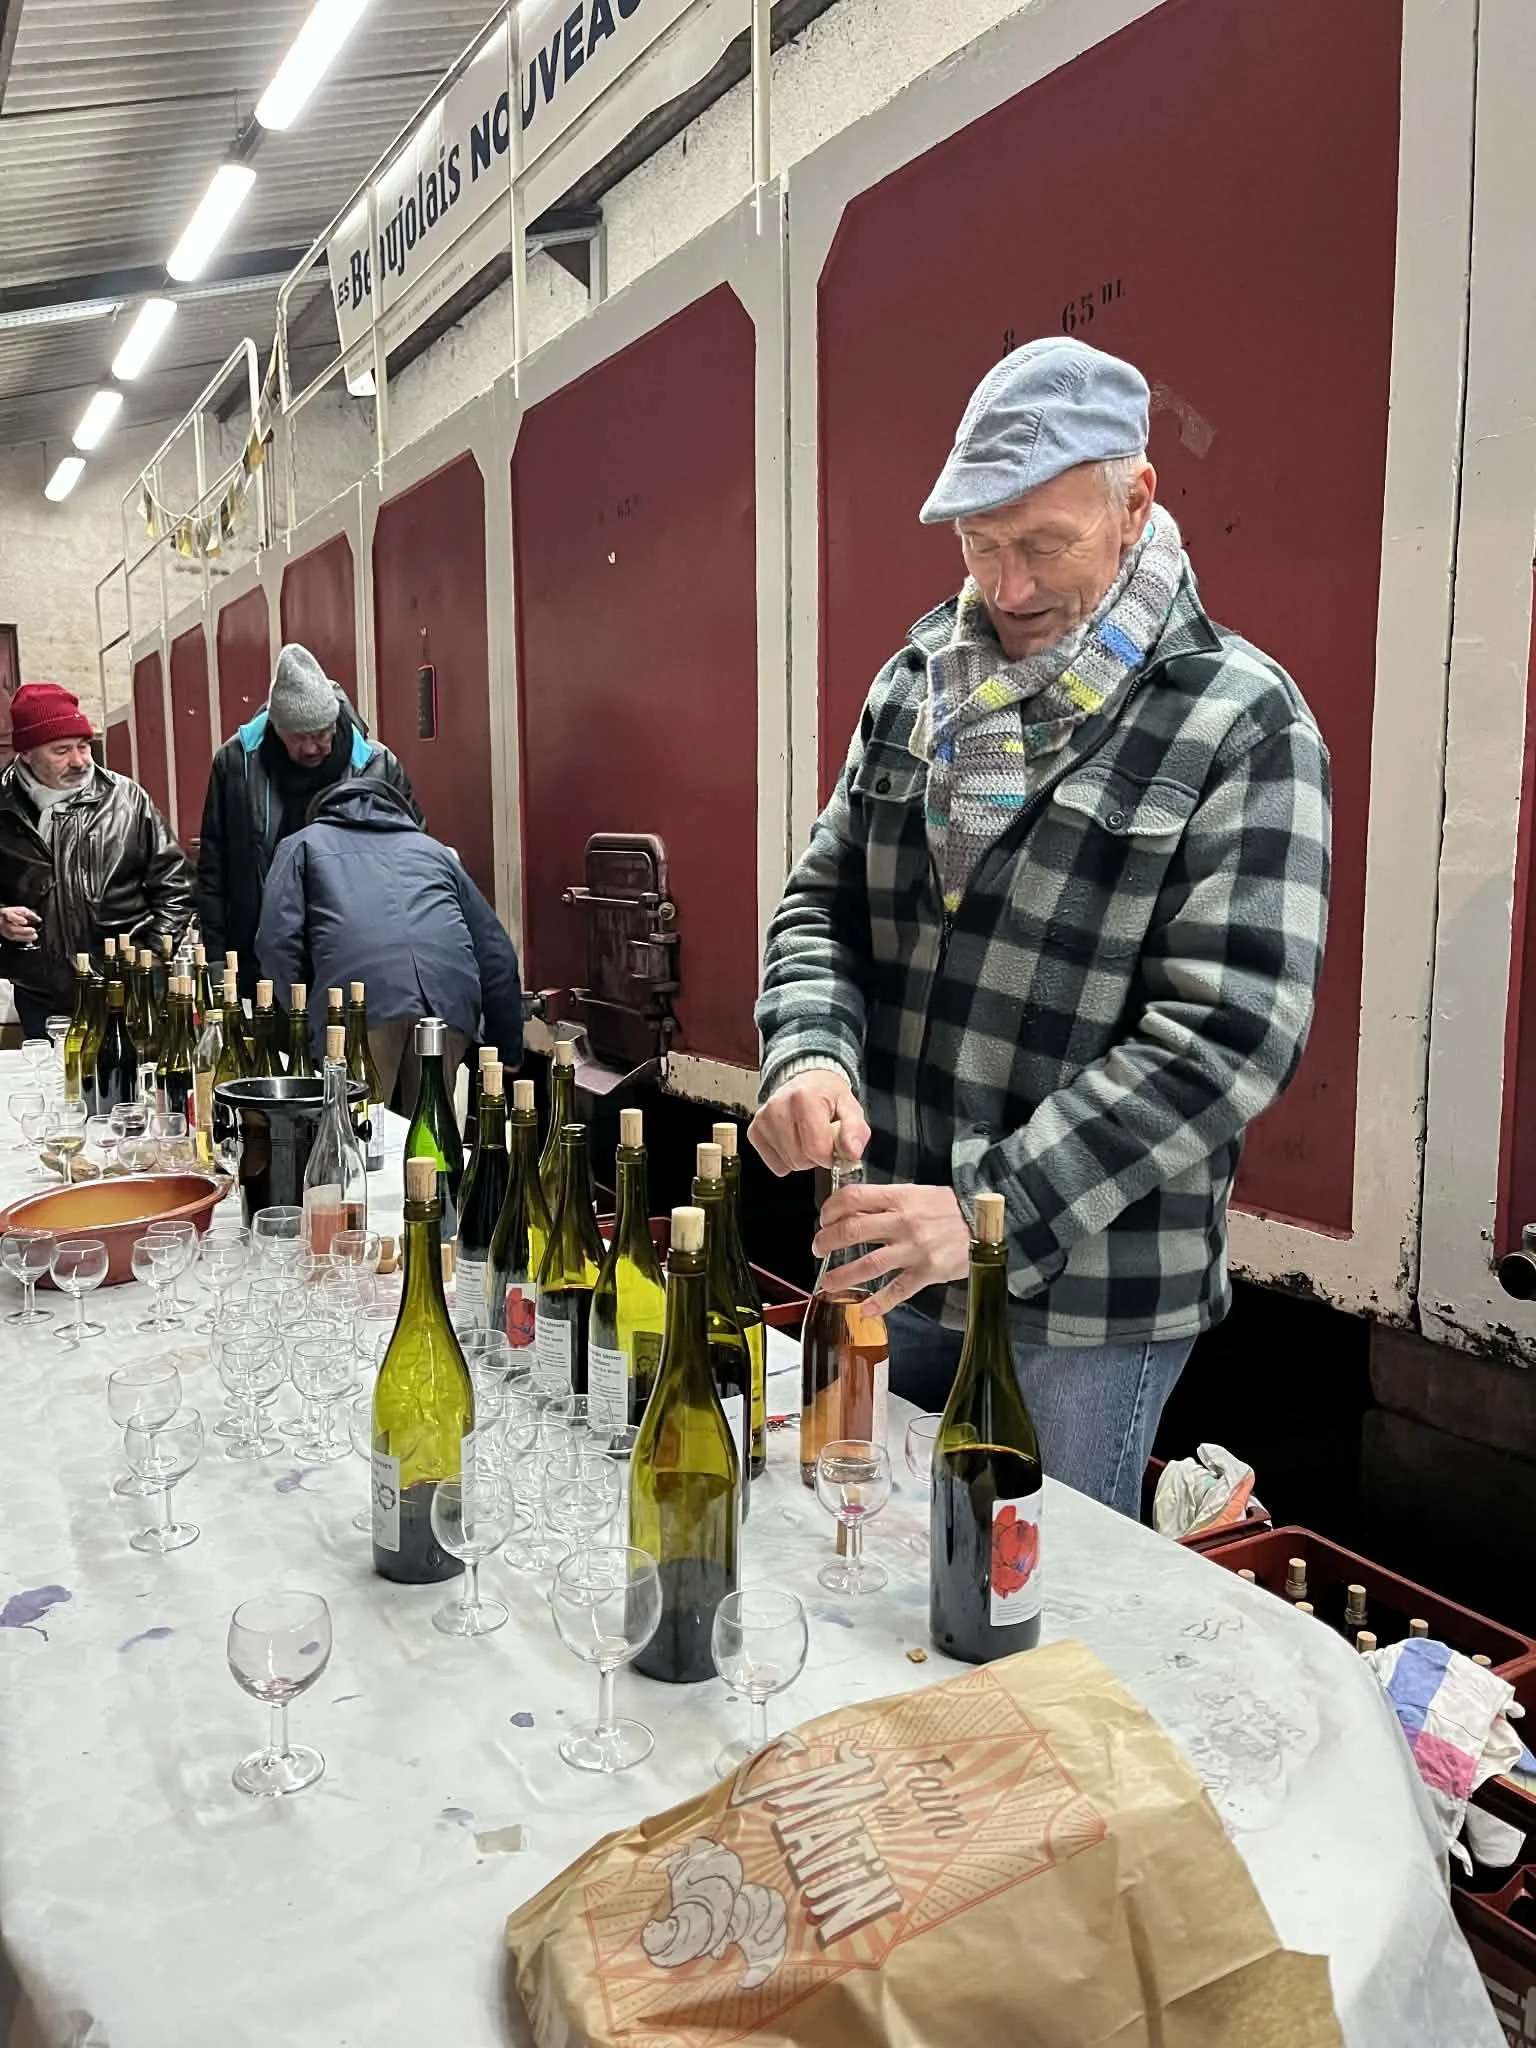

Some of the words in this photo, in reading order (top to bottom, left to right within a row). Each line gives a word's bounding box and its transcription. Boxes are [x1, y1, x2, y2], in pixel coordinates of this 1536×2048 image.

[470, 0, 643, 183] NOUVEA
[1061, 292, 1095, 334] 65
[871, 1804, 906, 1832] du
